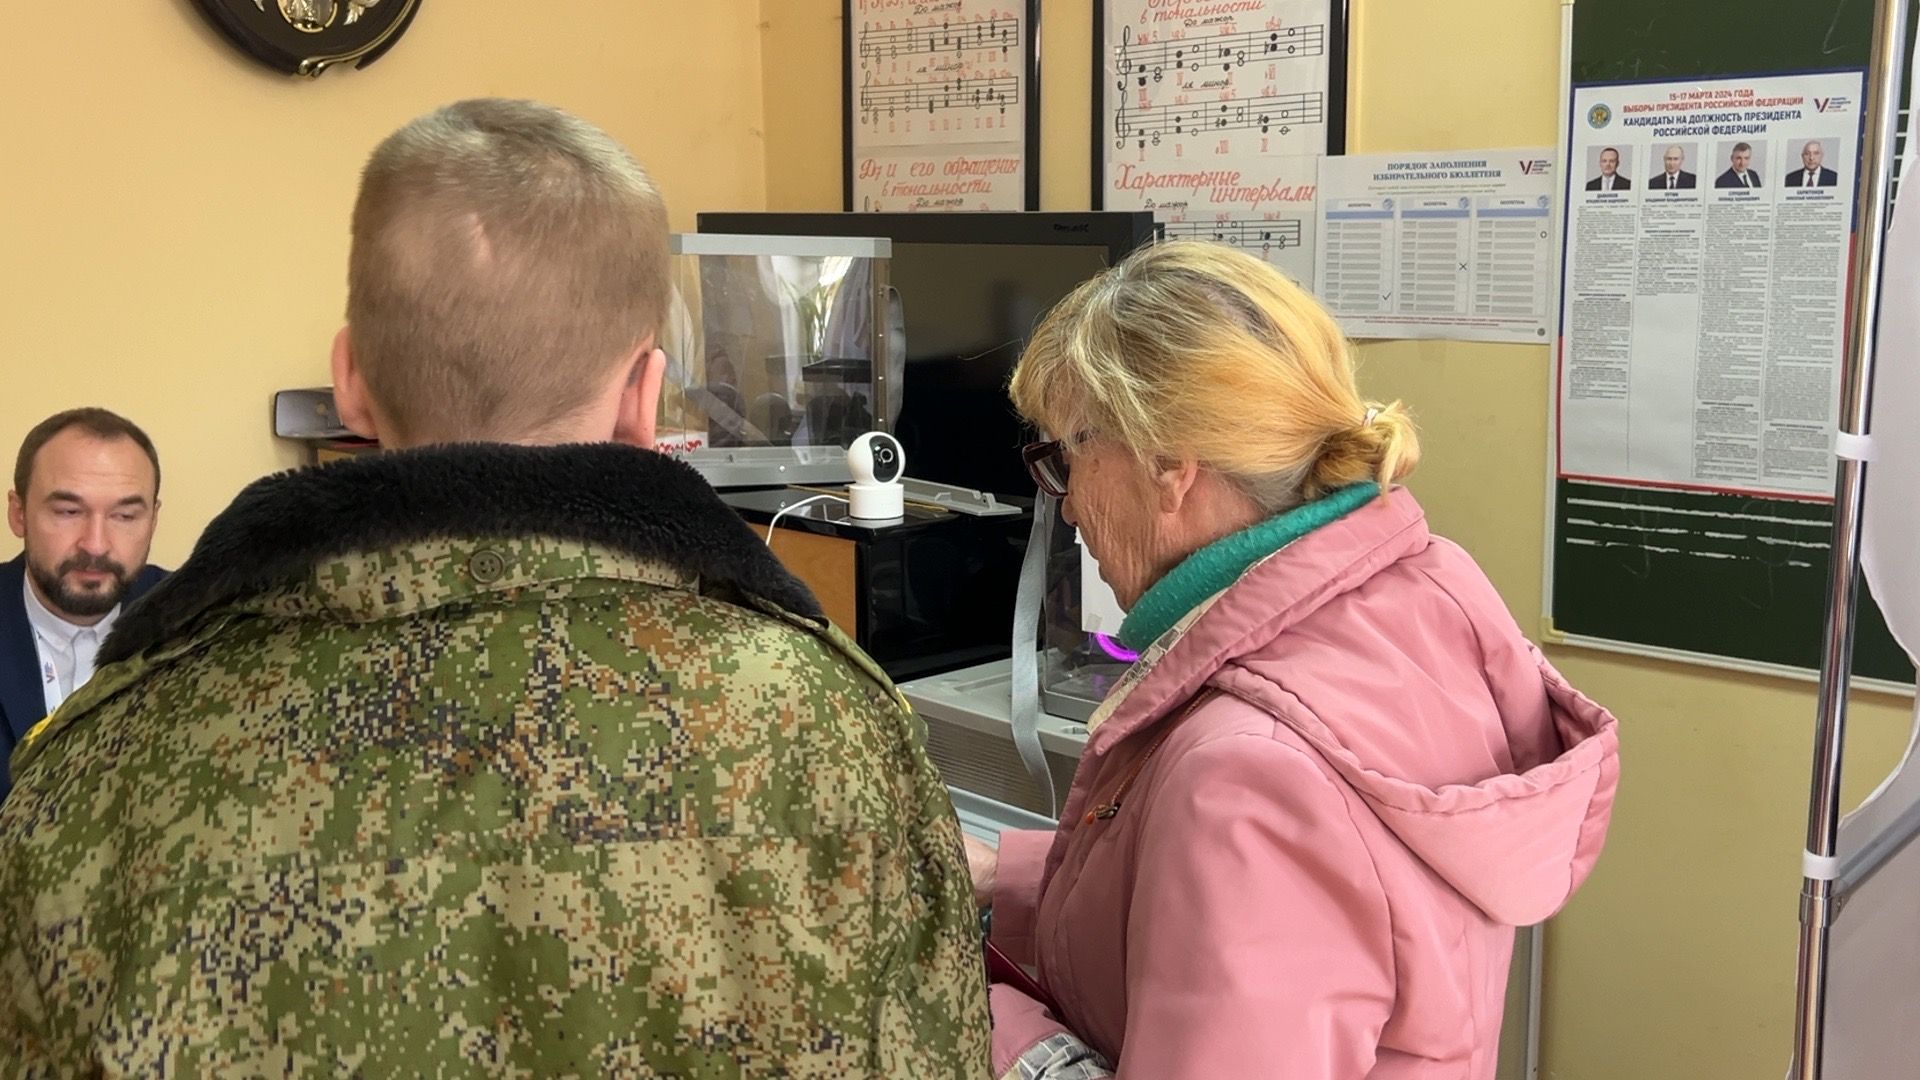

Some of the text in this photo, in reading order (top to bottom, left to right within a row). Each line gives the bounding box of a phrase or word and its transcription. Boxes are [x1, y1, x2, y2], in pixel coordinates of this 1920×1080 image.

[1140, 9, 1148, 24] в
[1153, 0, 1265, 23] тональности
[1688, 91, 1713, 100] МАРТА
[1714, 90, 1732, 99] 2024
[1734, 89, 1754, 98] ГОДА
[1623, 97, 1804, 113] ВЫБОРЫ ПРЕЗИДЕНТА РОССИЙСКОЙ ФЕДЕРАЦИИ
[1623, 110, 1802, 126] КАНДИДАТЫ НА ДОЛЖНОСТЬ ПРЕЗИДЕНТА
[1653, 123, 1766, 137] РОССИЙСКОЙ ФЕДЕРАЦИИ
[886, 163, 897, 178] и
[910, 161, 935, 177] его
[943, 157, 1020, 180] обращения
[1387, 160, 1487, 171] ПОРЯДОК ЗАПОЛНЕНИЯ
[1114, 163, 1241, 199] Характерные
[1373, 169, 1501, 181] ИЗБИРАТЕЛЬНОГО БЮЛЛЕТЕНЯ
[891, 179, 992, 197] тональности
[1209, 178, 1316, 211] интервалы
